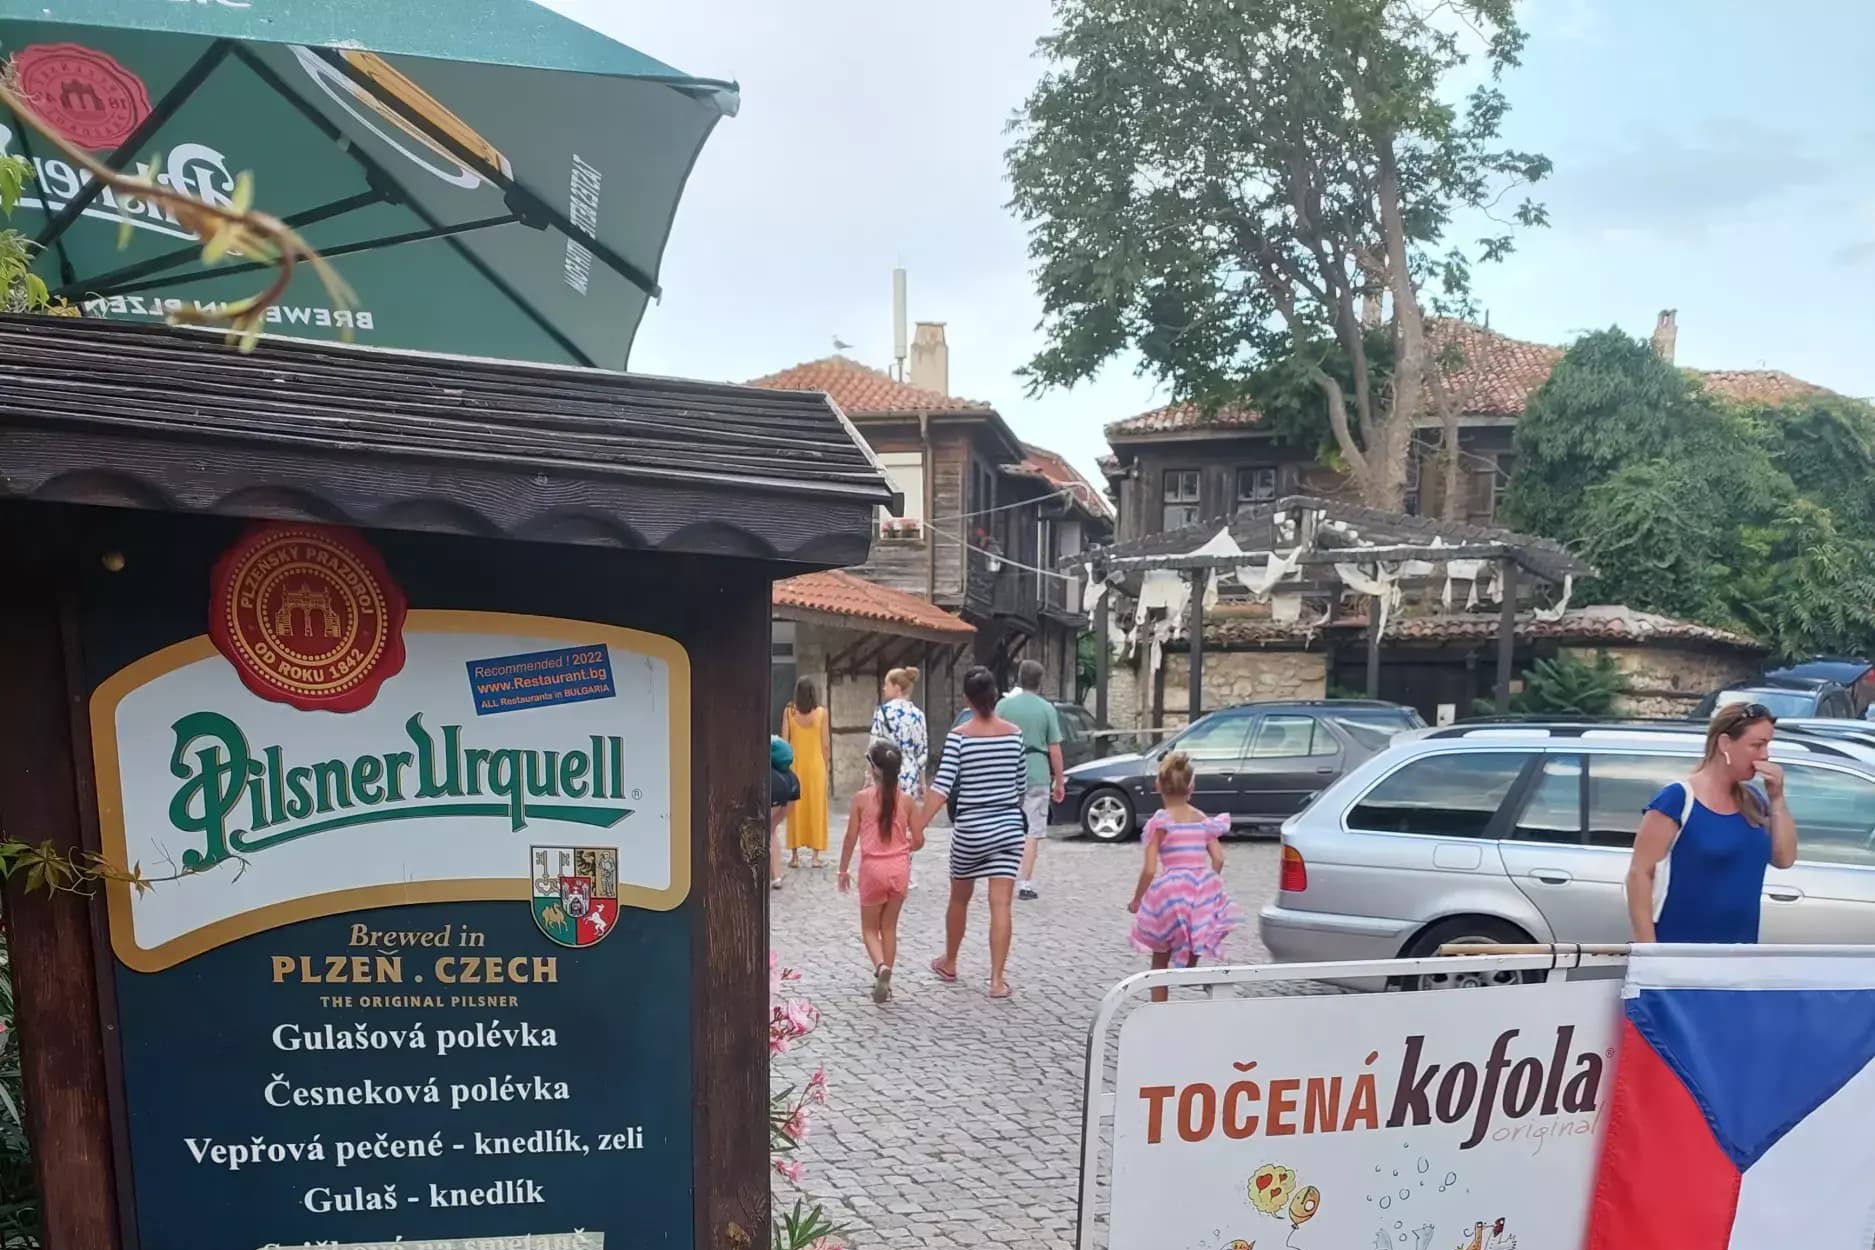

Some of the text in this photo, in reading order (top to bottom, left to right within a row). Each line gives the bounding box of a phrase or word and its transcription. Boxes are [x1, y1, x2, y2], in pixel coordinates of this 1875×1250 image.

[306, 548, 374, 614] PRAZDROJ
[254, 642, 364, 682] OD ROKU 1842
[474, 656, 563, 678] Recommended
[572, 651, 603, 666] 2022
[477, 667, 607, 695] www.Restaurant.bg
[481, 697, 499, 709] ALL
[500, 691, 553, 707] Restaurants
[564, 684, 610, 698] BULGARIA
[168, 711, 626, 873] Pilsner Urquell
[349, 923, 486, 948] Brewed in
[434, 956, 558, 984] CZECH
[320, 995, 519, 1009] THE ORIGINAL PILSNER
[272, 1020, 558, 1055] Gulašová polévka
[264, 1073, 570, 1109] Česneková polévka
[1139, 1025, 1603, 1150] TOČENÁ kofola
[184, 1132, 326, 1170] Vepřová
[336, 1131, 444, 1166] pečené
[474, 1129, 591, 1157] knedlík,
[598, 1126, 645, 1152] zeli
[304, 1184, 398, 1213] Gulaš
[429, 1180, 545, 1208] knedlík
